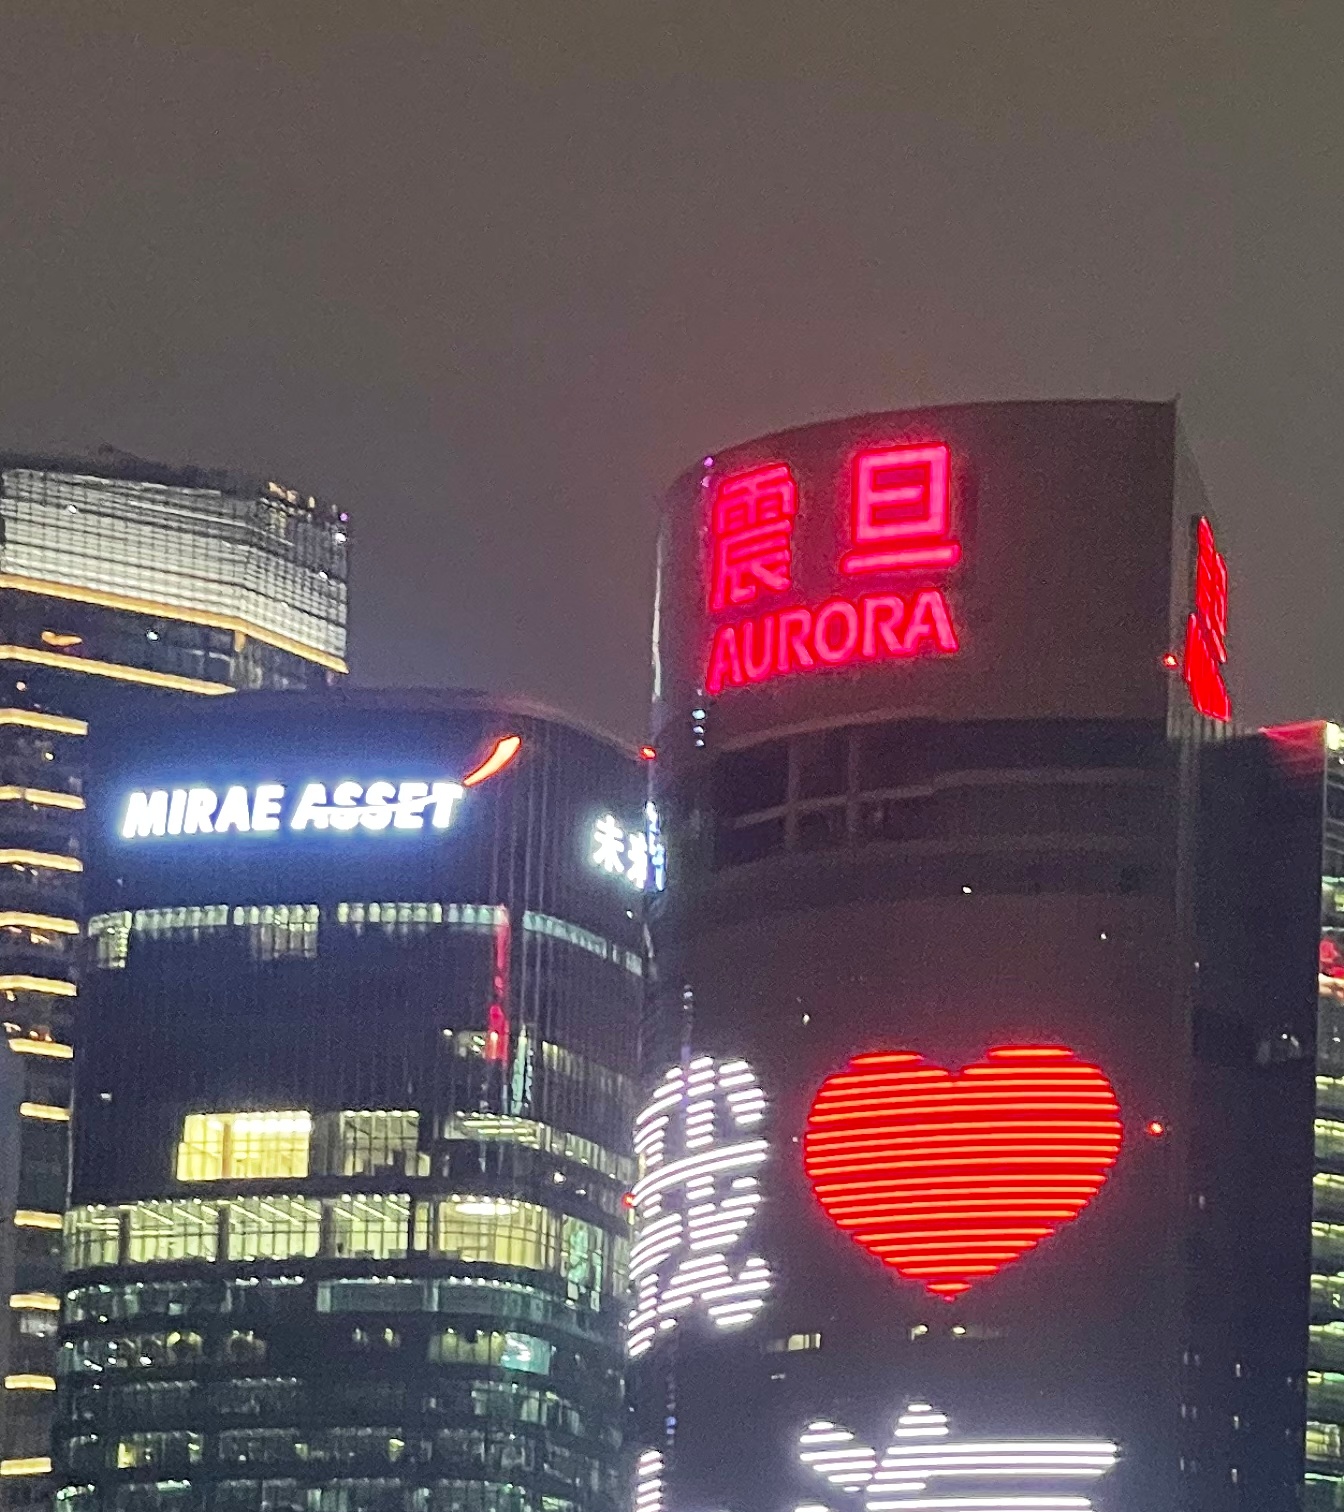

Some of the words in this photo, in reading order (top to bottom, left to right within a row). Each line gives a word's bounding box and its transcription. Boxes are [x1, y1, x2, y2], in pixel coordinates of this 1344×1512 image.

[711, 441, 963, 612] 震旦
[705, 587, 960, 695] AURORA
[122, 783, 285, 838] MIRAE
[291, 781, 464, 830] ASSET
[628, 1055, 772, 1358] 我
